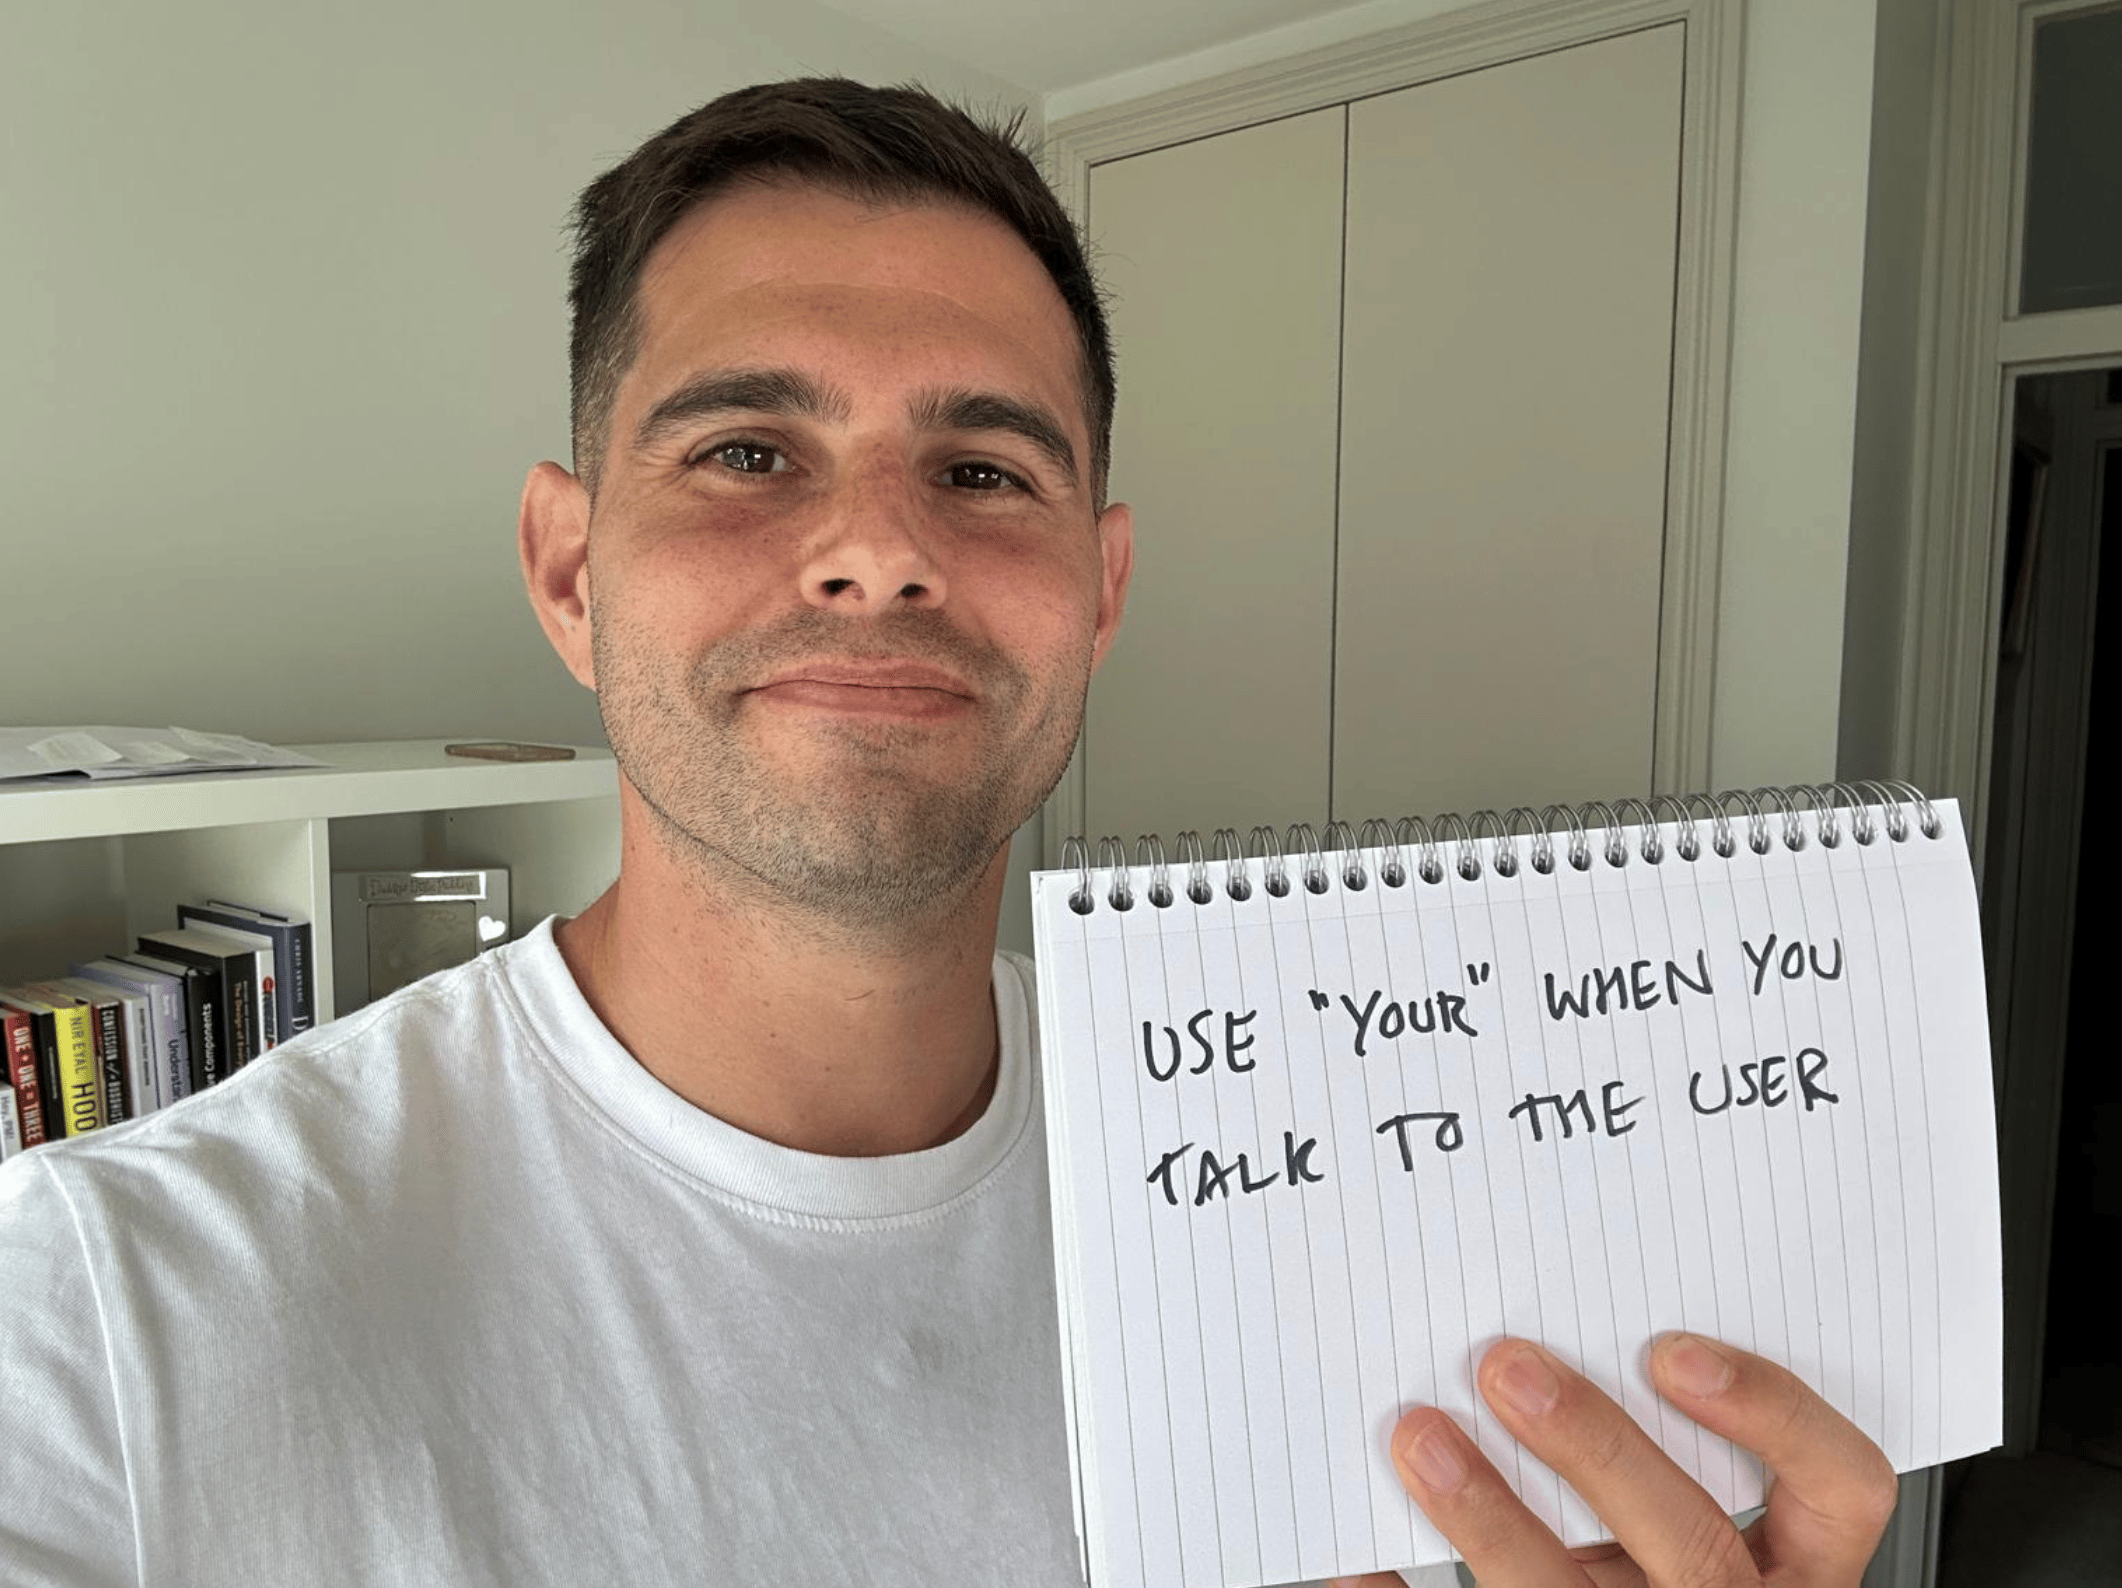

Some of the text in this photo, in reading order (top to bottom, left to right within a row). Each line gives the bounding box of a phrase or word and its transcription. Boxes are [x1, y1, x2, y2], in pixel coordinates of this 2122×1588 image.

[1142, 933, 1842, 1082] USE "YOUR" WHEN YOU
[13, 1026, 32, 1053] ONE
[202, 1002, 216, 1073] Components
[18, 1064, 37, 1090] ONE
[22, 1101, 43, 1143] THREE
[71, 1082, 98, 1132] HOO
[1146, 1047, 1839, 1207] TALK TO THE USER
